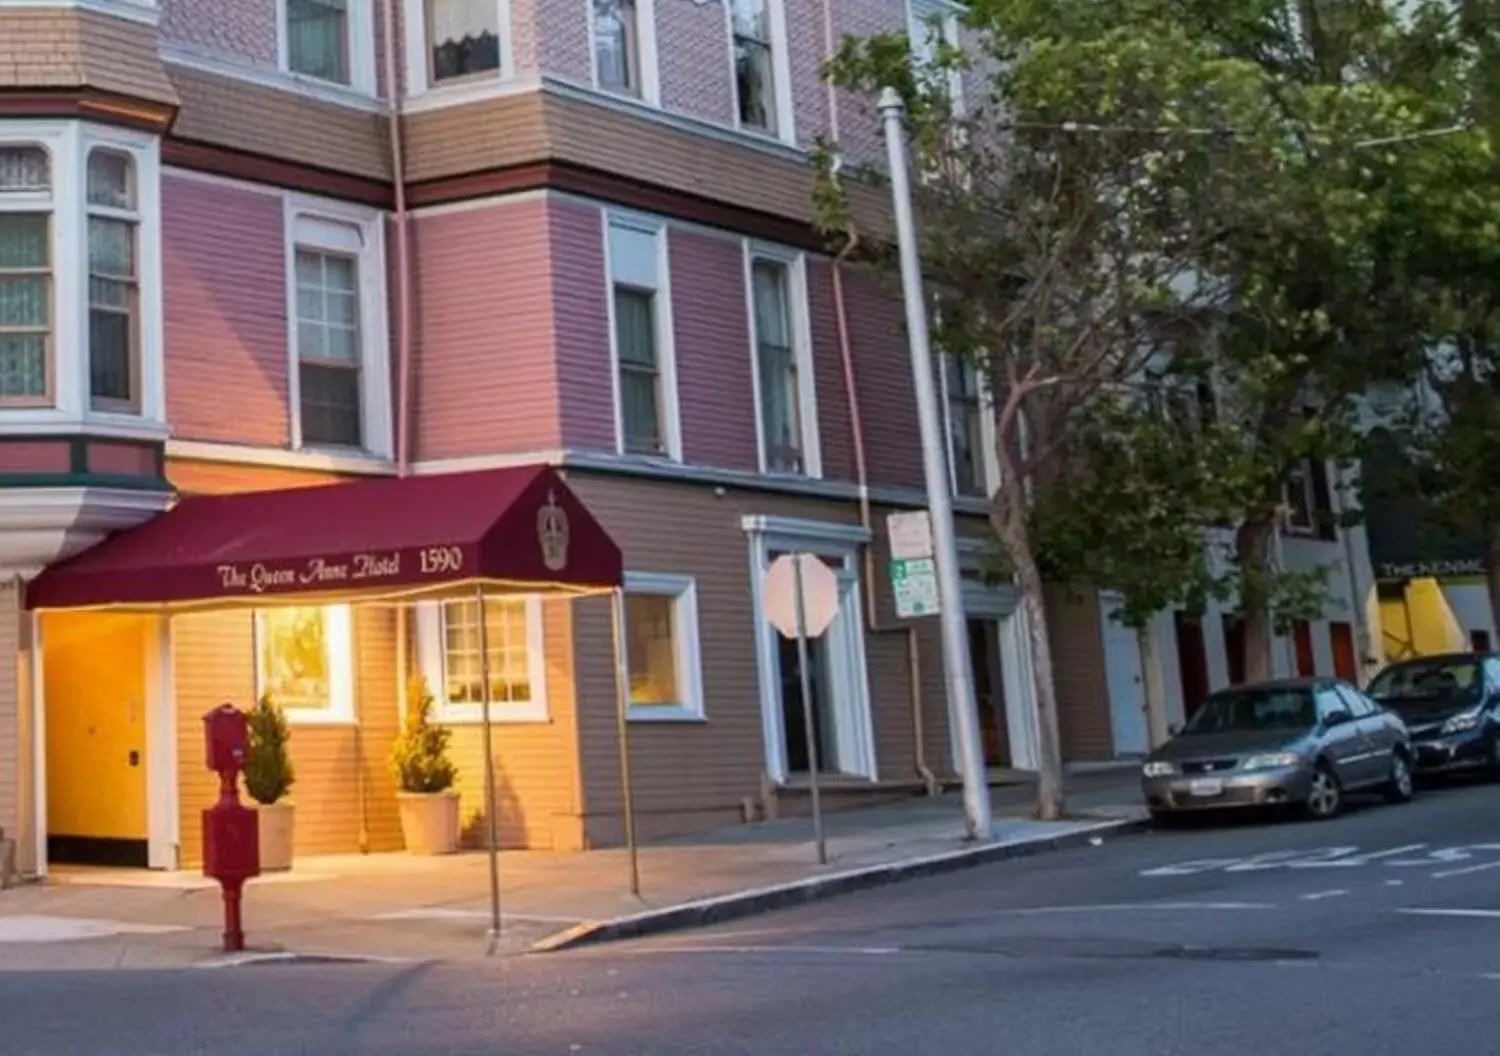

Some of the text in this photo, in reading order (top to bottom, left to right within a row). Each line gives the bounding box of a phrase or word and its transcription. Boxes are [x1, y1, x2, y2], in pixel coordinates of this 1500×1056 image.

[217, 546, 463, 592] The Queen Anne Hotel 1590
